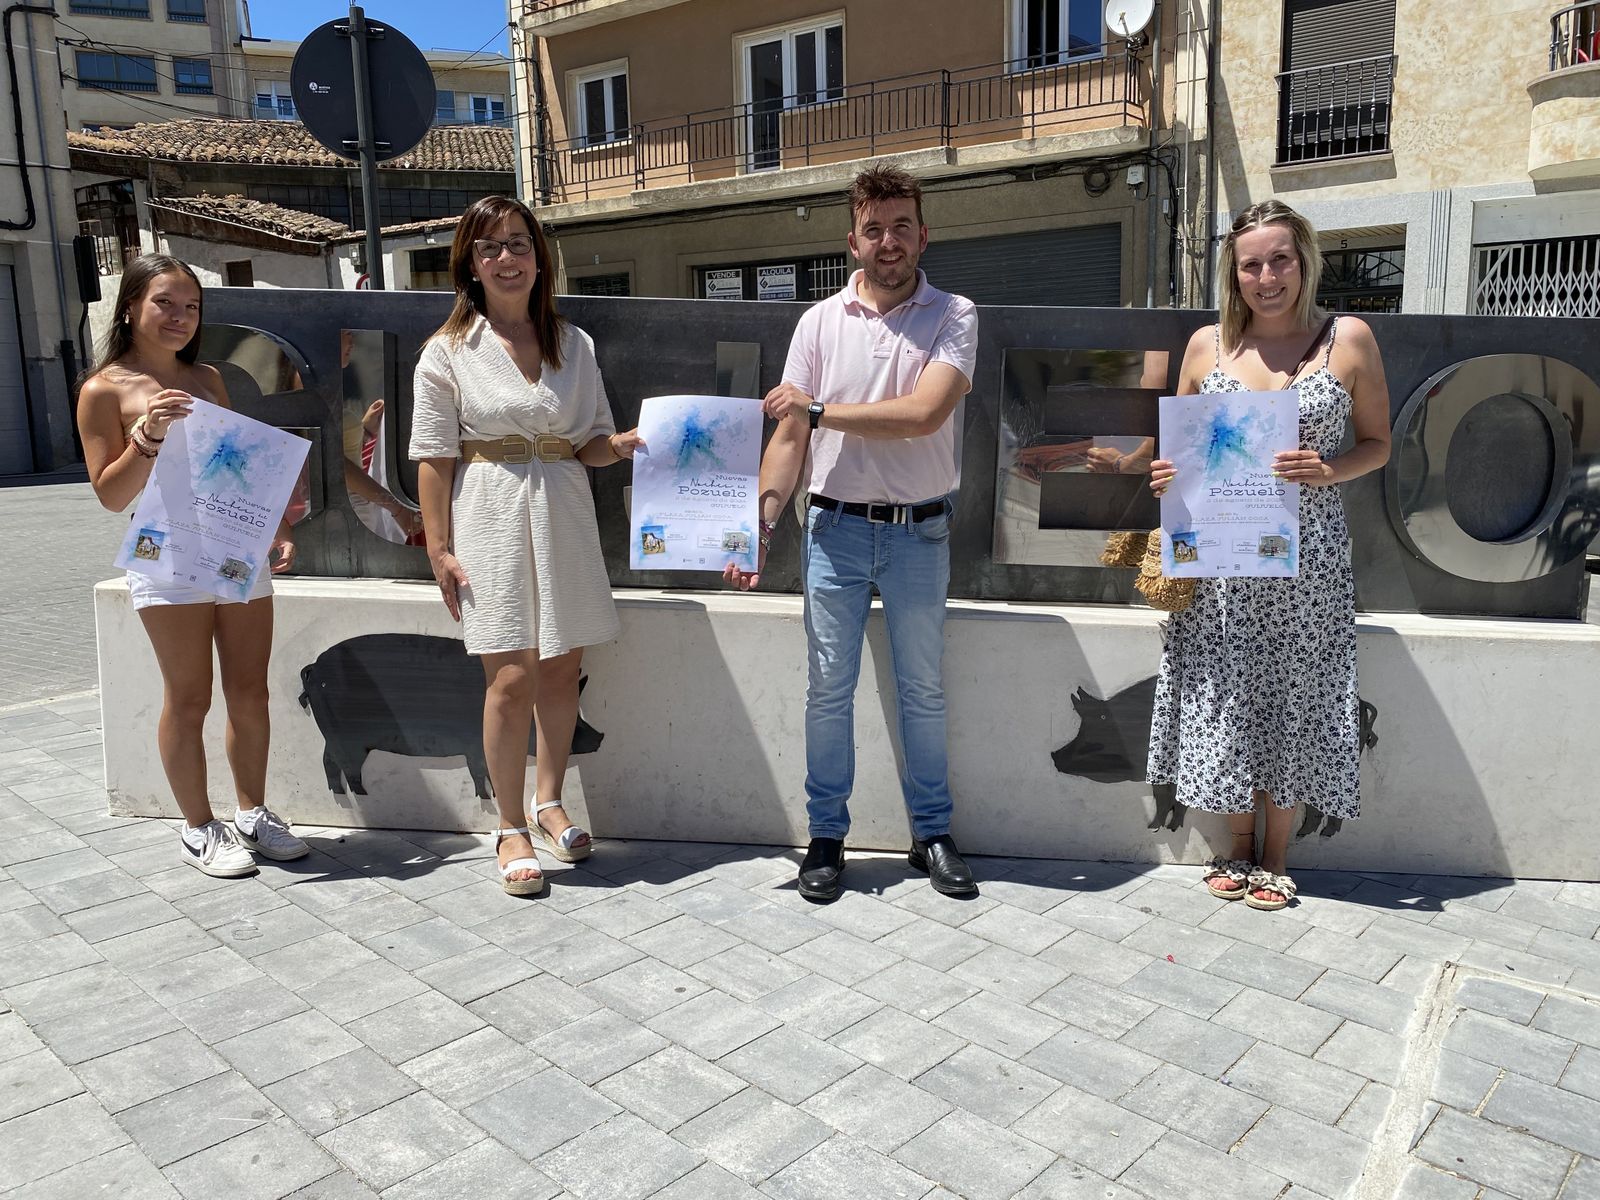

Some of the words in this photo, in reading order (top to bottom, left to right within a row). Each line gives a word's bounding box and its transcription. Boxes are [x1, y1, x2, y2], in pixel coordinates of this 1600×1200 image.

[1340, 239, 1348, 249] 5
[761, 268, 792, 276] ALQUILA
[1222, 478, 1271, 488] Noches
[678, 486, 747, 498] Pozuelo
[1209, 487, 1286, 496] Pozuelo
[238, 496, 271, 513] Nuevas
[192, 497, 266, 528] Pozuelo
